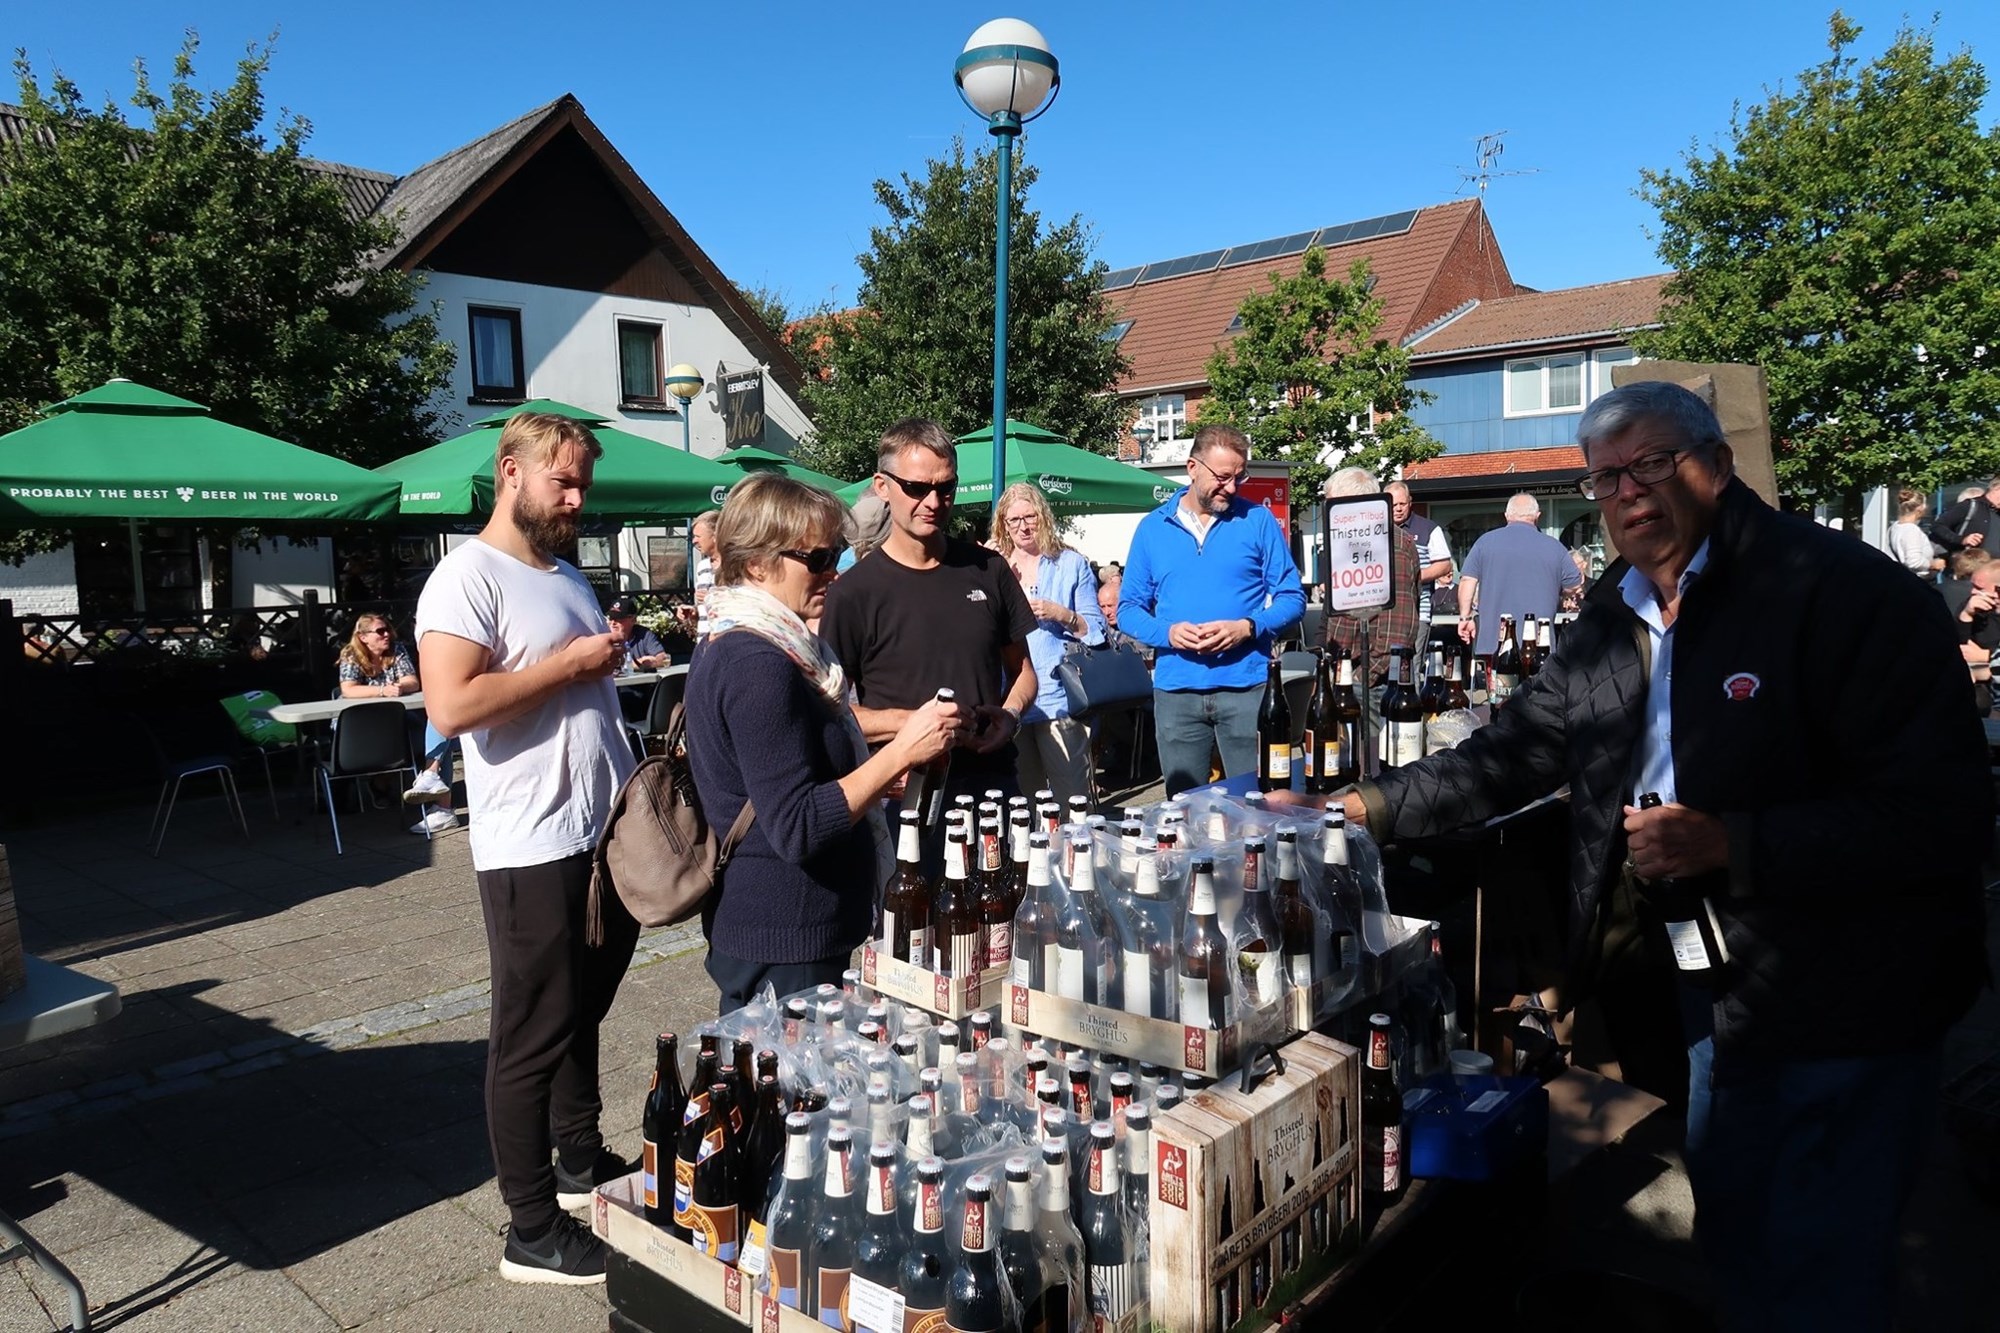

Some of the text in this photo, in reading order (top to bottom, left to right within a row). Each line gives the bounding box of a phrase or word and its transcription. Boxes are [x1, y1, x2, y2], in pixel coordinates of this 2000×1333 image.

[728, 393, 766, 443] Kro
[970, 483, 993, 492] WORLD
[1039, 473, 1072, 495] Carlsberg
[10, 488, 339, 502] PROBABLY THE BEST BEER IN THE WORLD
[410, 492, 421, 501] THE
[421, 491, 441, 501] WORLD
[1334, 511, 1385, 525] Super Tilbud
[1330, 523, 1389, 540] Thisted ØL
[1352, 550, 1376, 564] 5 fl.
[1087, 1014, 1118, 1030] Thisted
[1080, 1021, 1128, 1044] BRYGHUS
[1273, 1112, 1304, 1142] Thisted
[1267, 1121, 1312, 1166] BRYGHUS
[1224, 1228, 1250, 1265] ÅRETS
[1252, 1200, 1290, 1243] BRYGGERI
[1312, 1167, 1328, 1195] 2016
